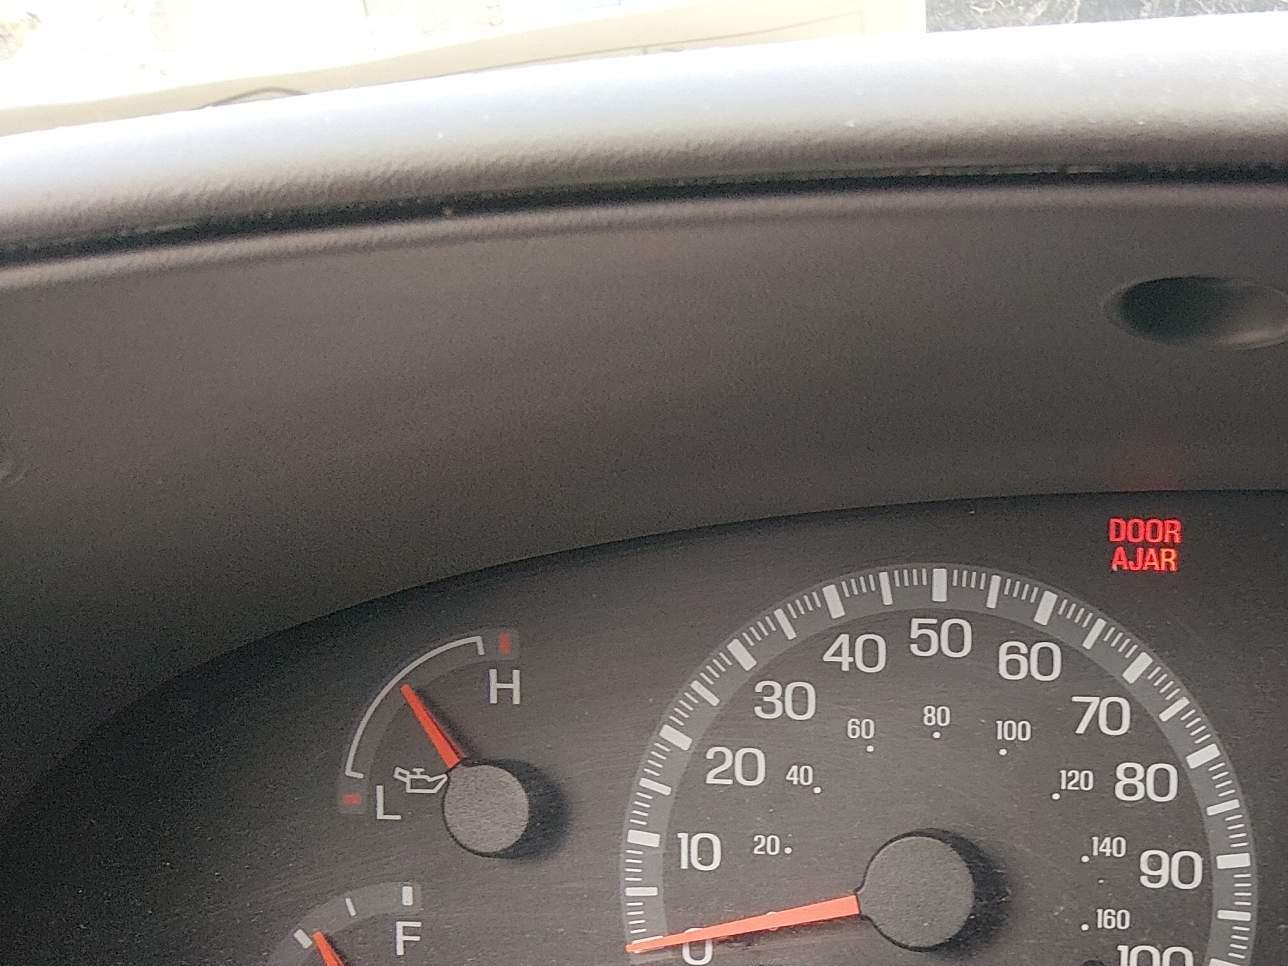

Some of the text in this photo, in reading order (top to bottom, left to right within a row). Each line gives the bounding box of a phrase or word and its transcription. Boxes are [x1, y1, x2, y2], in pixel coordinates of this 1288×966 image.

[1110, 518, 1181, 543] DOOR
[1112, 546, 1177, 571] AJAR
[823, 634, 886, 672] 40
[910, 619, 971, 657] 50
[999, 642, 1061, 681] 60
[490, 669, 520, 704] H
[755, 681, 815, 720] 30
[848, 719, 874, 739] 60
[924, 706, 950, 726] 80
[996, 721, 1030, 740] 100
[1072, 697, 1130, 735] 70
[706, 747, 765, 785] 20
[786, 766, 812, 785] 40
[1060, 770, 1093, 790] 120
[1115, 763, 1177, 801] 80
[376, 786, 401, 819] L
[678, 833, 721, 870] 10
[754, 835, 779, 855] 20
[1092, 837, 1126, 857] 140
[1140, 850, 1202, 889] 90
[1097, 909, 1130, 929] 160
[396, 922, 421, 955] F
[682, 927, 712, 965] 0
